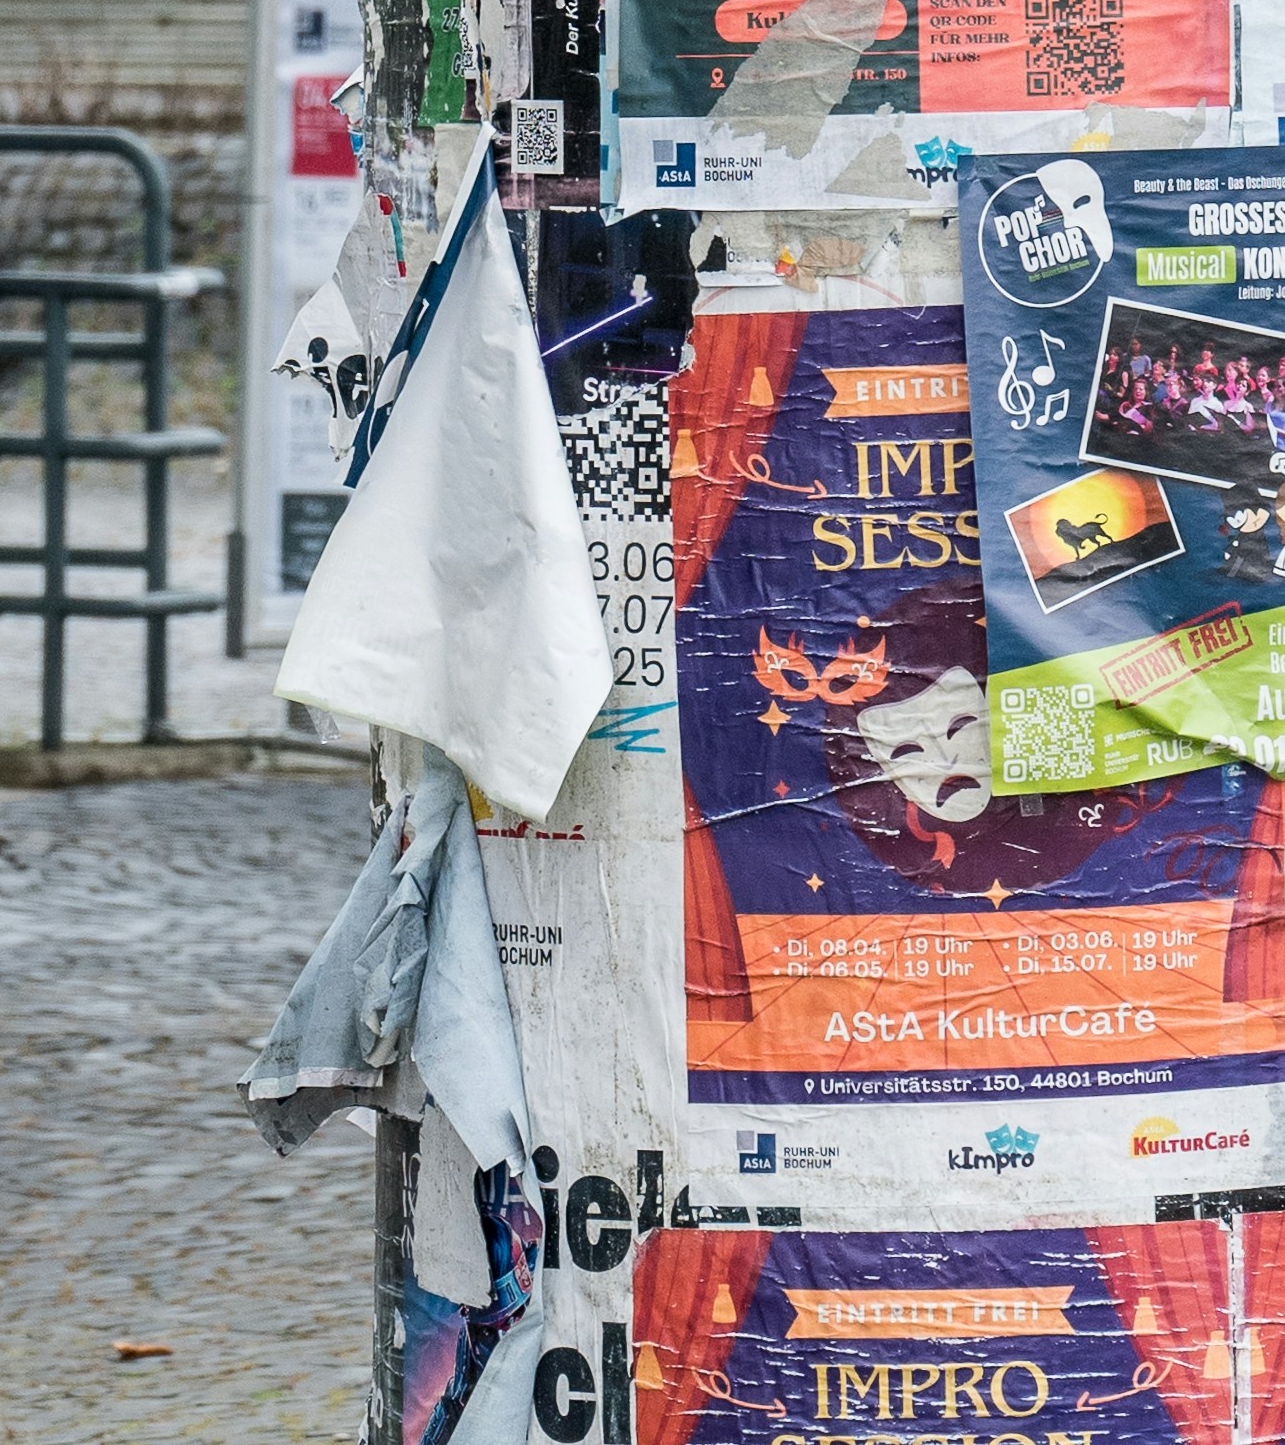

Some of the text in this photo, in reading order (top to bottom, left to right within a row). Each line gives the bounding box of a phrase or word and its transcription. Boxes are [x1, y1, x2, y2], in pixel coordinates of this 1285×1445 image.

[565, 25, 579, 55] Der
[930, 32, 1009, 45] FÜR MEHR
[930, 52, 981, 63] INFOS:
[883, 69, 907, 80] 150
[704, 157, 762, 168] RUHR-UNI
[661, 171, 691, 182] AStA
[704, 170, 753, 181] BOCHUM
[1134, 179, 1165, 194] Beauty
[1176, 179, 1191, 190] the
[1194, 178, 1218, 191] Beast
[1228, 178, 1244, 190] Das
[994, 206, 1043, 247] POP
[1019, 227, 1087, 272] CHOR
[1147, 252, 1226, 280] Musical
[1238, 286, 1274, 301] Leitung:
[1114, 617, 1238, 698] EINTRITT FREI
[1147, 736, 1193, 766] RUB
[787, 930, 1198, 959] Di, 08.04. 19 Uhr Di, 03.06. 19 Uhr
[1050, 954, 1113, 973] 15.07.
[824, 1005, 1156, 1043] AStA KulturCafé
[820, 1067, 1173, 1095] Universitätsstr. 150, 44801 Bochum
[817, 1301, 1040, 1324] EINTRITT FREI
[812, 1361, 1048, 1421] IMPRO
